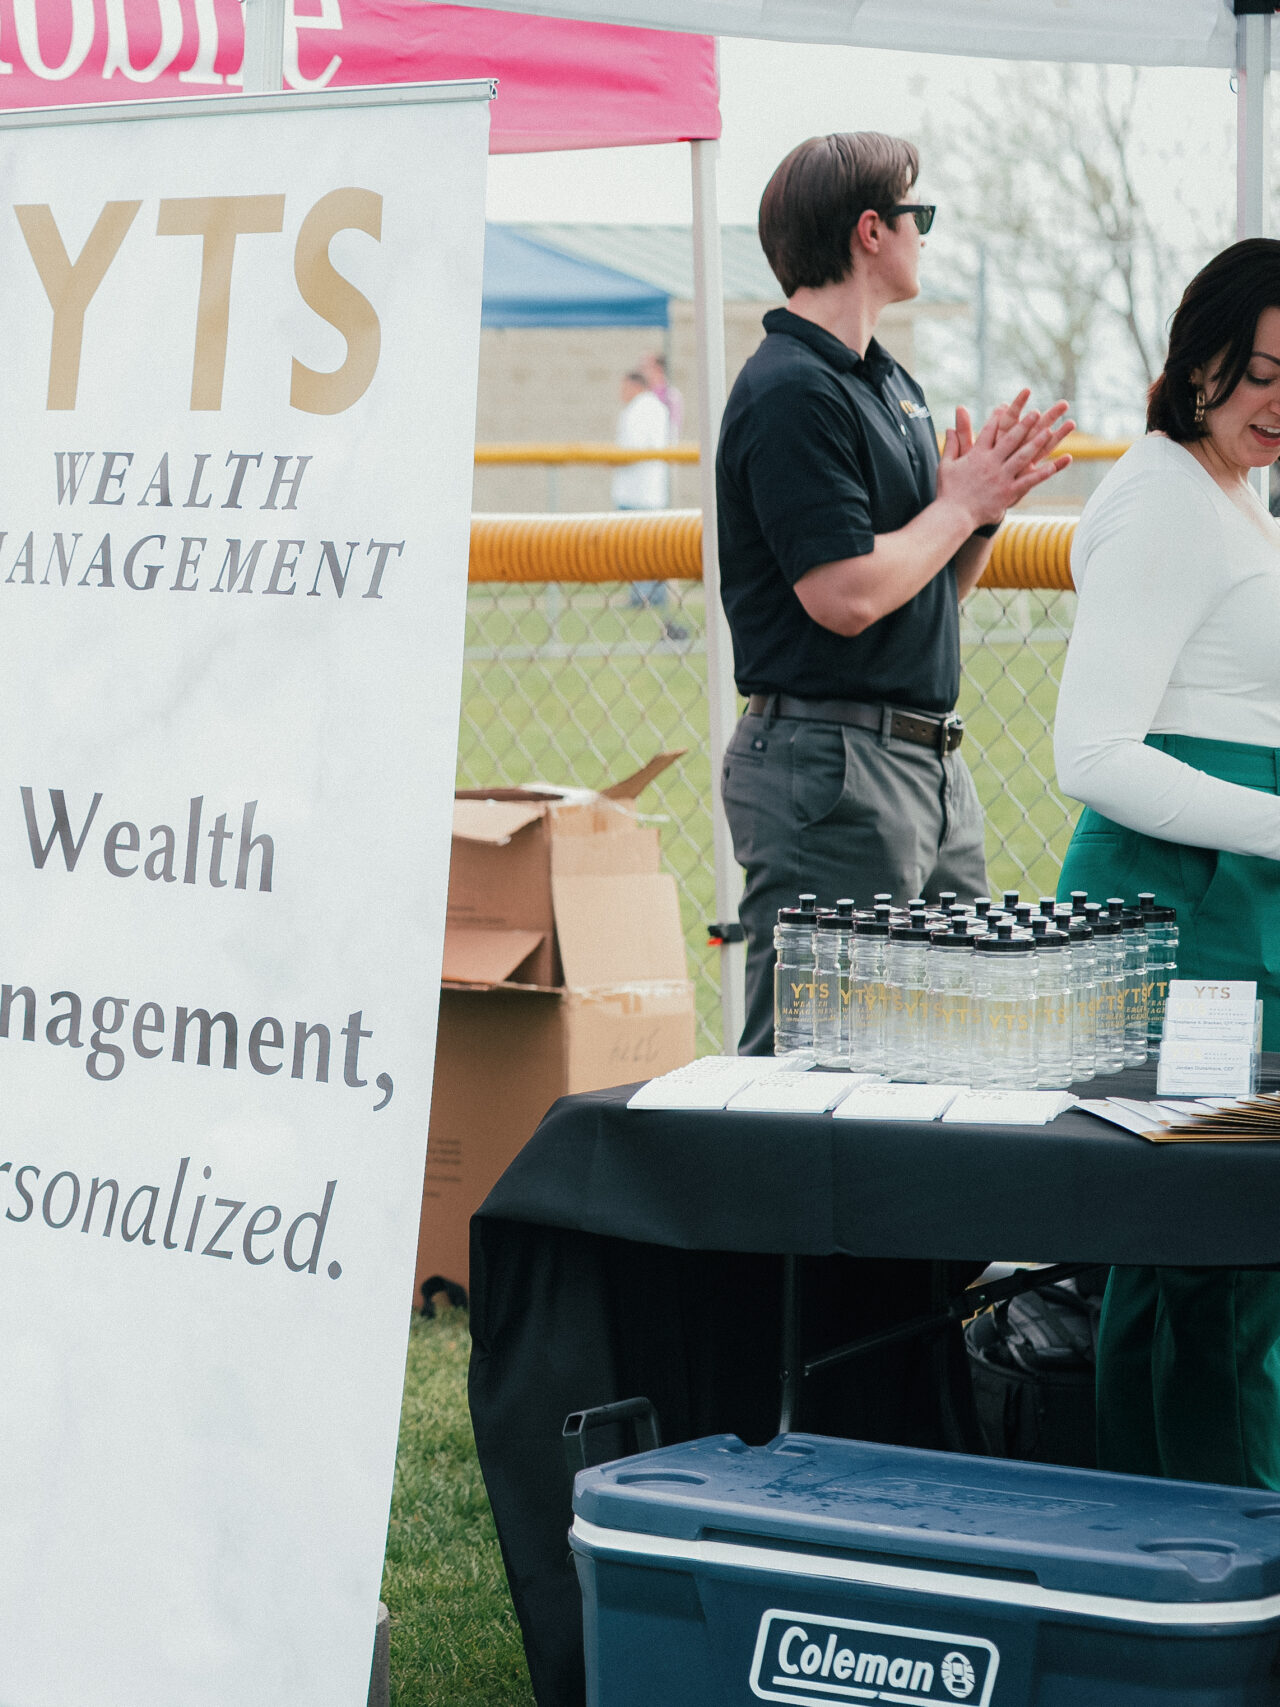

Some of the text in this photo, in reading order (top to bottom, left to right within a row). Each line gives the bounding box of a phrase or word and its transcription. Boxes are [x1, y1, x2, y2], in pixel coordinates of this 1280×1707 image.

[13, 186, 384, 416] YTS
[54, 450, 313, 510] WEALTH
[20, 786, 275, 892] Wealth
[790, 983, 830, 999] YTS
[1194, 986, 1231, 999] YTS
[778, 1626, 935, 1692] Coleman
